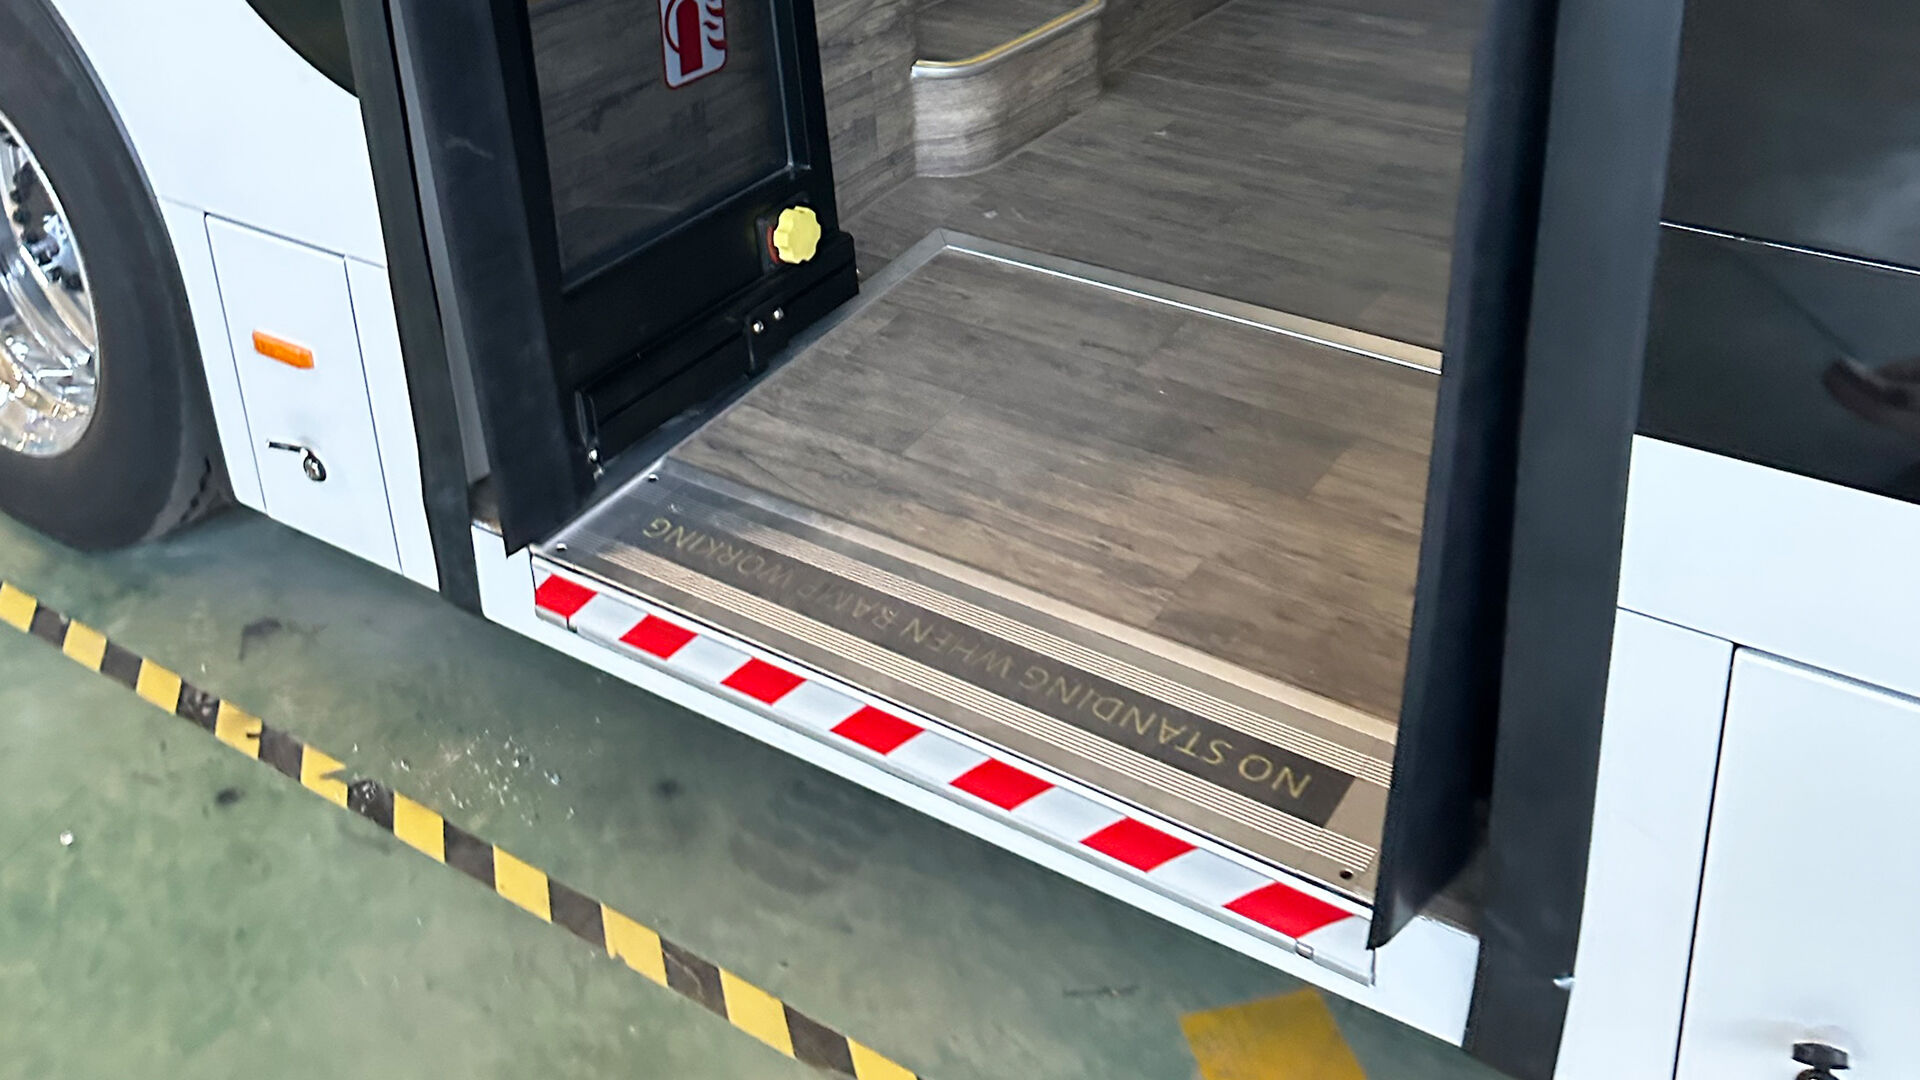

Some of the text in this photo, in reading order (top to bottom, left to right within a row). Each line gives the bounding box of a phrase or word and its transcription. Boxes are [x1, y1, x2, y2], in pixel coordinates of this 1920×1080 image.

[642, 517, 794, 589] WORKING
[901, 617, 1015, 678] WHEN
[1018, 665, 1233, 765] STANDING
[1238, 754, 1312, 798] NO
